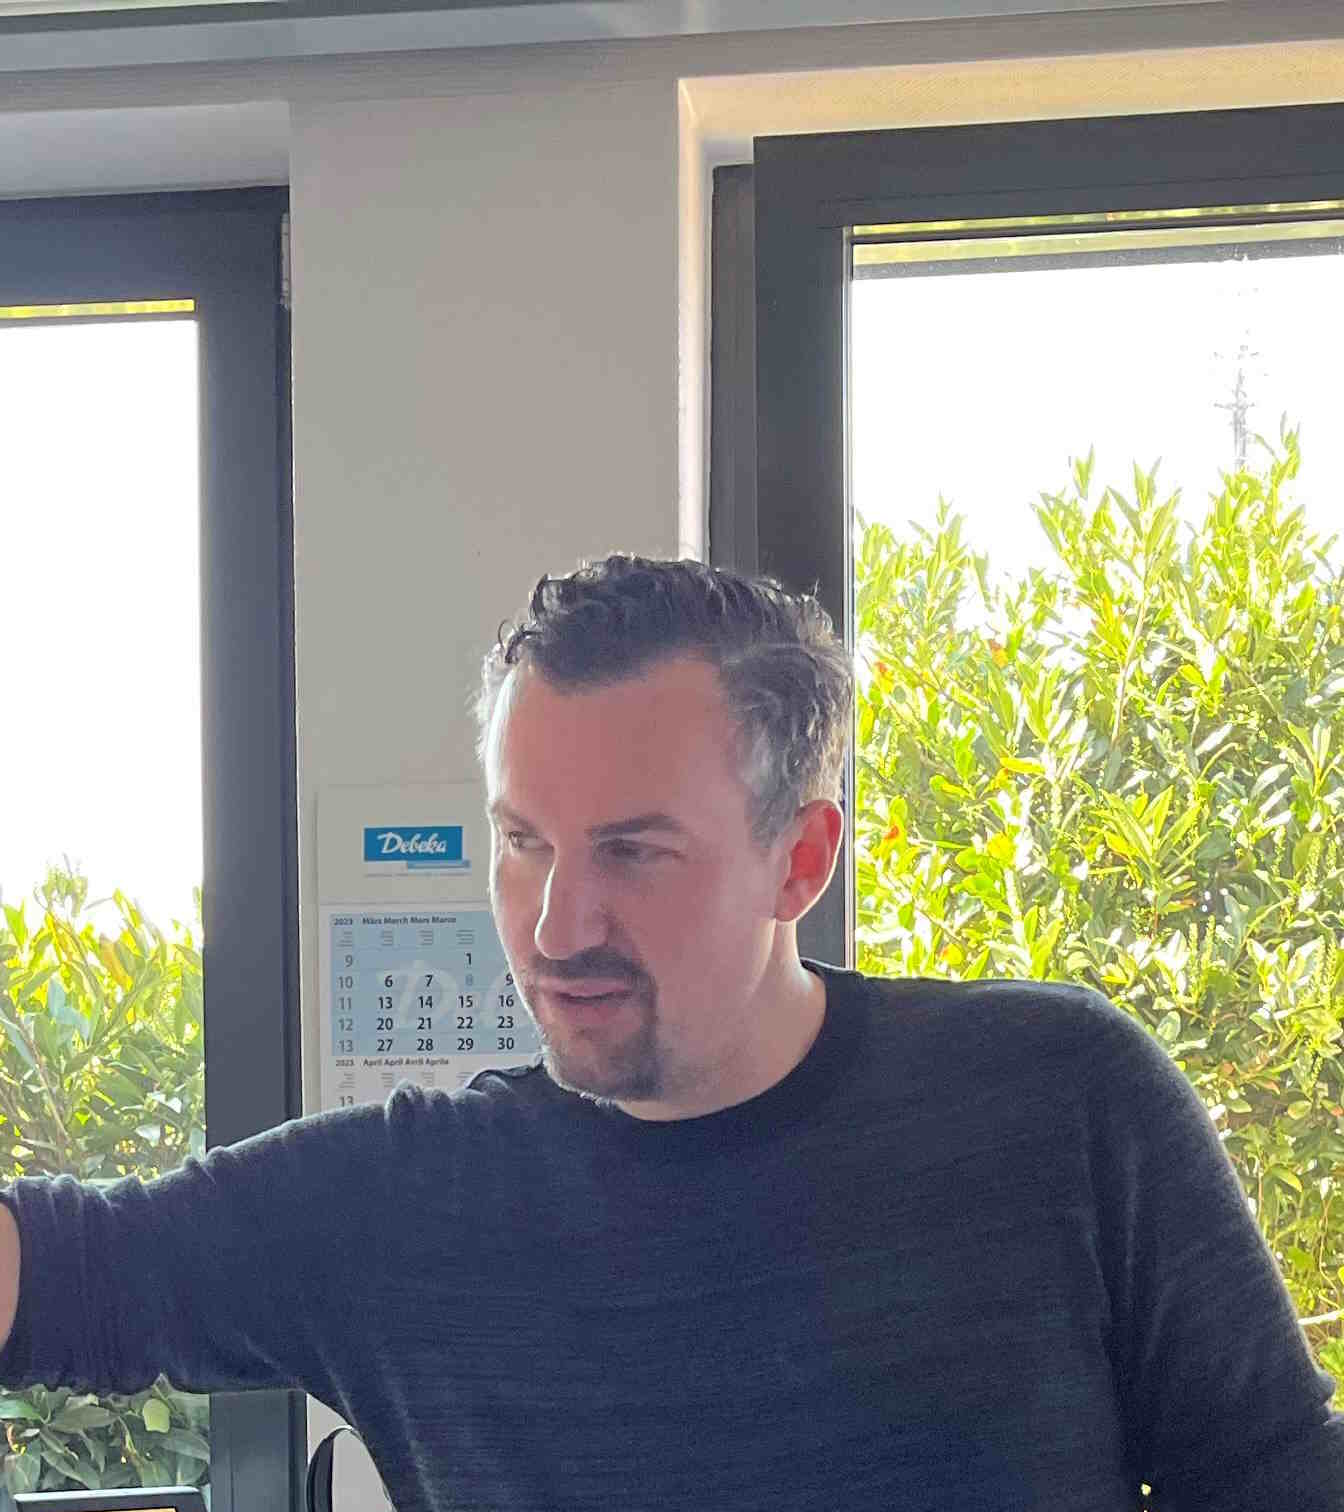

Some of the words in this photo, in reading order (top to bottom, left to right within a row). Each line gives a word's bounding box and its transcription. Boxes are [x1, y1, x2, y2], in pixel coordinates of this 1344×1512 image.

[377, 831, 447, 854] Debeka
[344, 954, 353, 968] 9
[465, 952, 473, 965] 1
[338, 976, 354, 990] 10
[384, 974, 394, 988] 6
[424, 974, 434, 987] 7
[505, 974, 514, 986] 9
[339, 997, 353, 1011] 11
[378, 996, 393, 1010] 13
[417, 995, 434, 1009] 14
[458, 995, 474, 1009] 15
[498, 995, 515, 1008] 16
[338, 1018, 354, 1031] 12
[376, 1017, 394, 1031] 20
[416, 1017, 433, 1031] 21
[457, 1016, 474, 1030] 22
[497, 1016, 515, 1029] 23
[338, 1039, 354, 1053] 13
[377, 1039, 394, 1052] 27
[416, 1038, 434, 1052] 28
[457, 1037, 474, 1051] 29
[497, 1037, 515, 1050] 30
